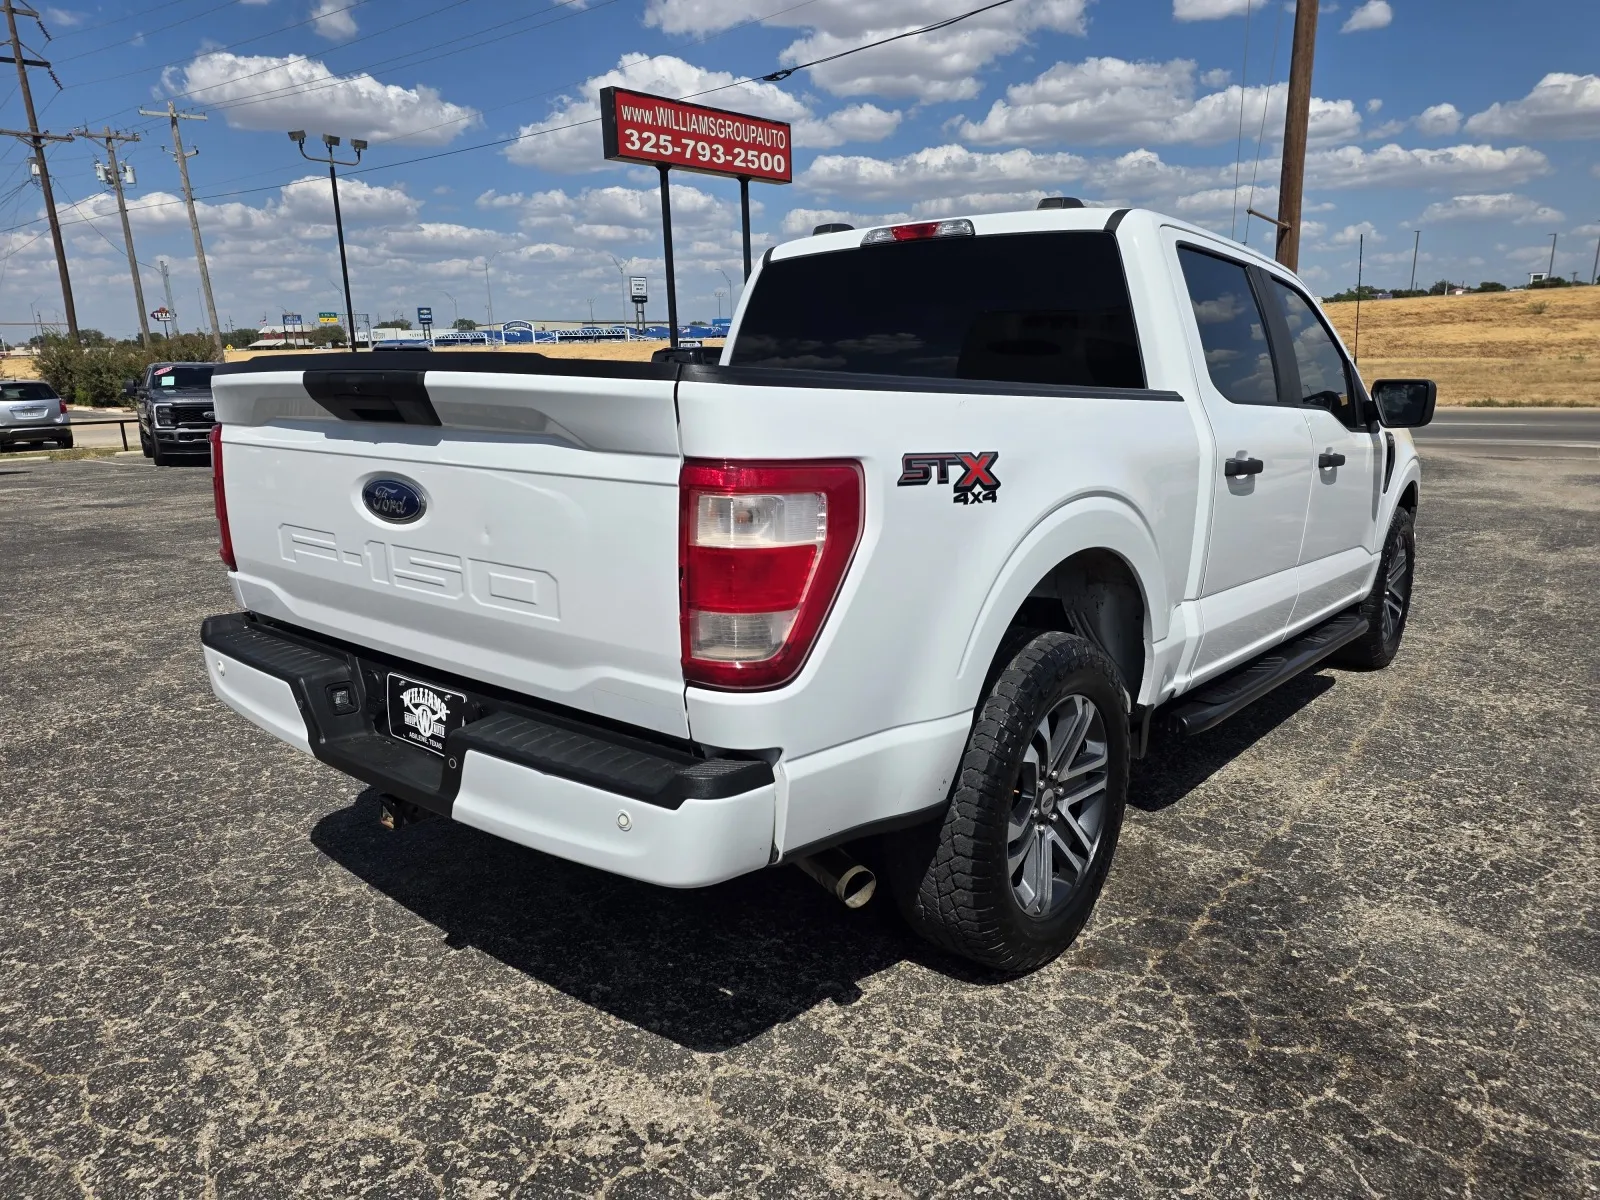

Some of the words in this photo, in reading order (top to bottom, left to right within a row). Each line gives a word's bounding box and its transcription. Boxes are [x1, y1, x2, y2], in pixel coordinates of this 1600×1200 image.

[624, 128, 786, 173] 325-793-2500
[897, 451, 1001, 493] STX
[372, 486, 406, 514] Ford
[278, 523, 560, 622] F-150
[402, 687, 448, 721] WILLIAMS
[429, 738, 442, 750] TEXAS
[433, 723, 445, 736] AUTO
